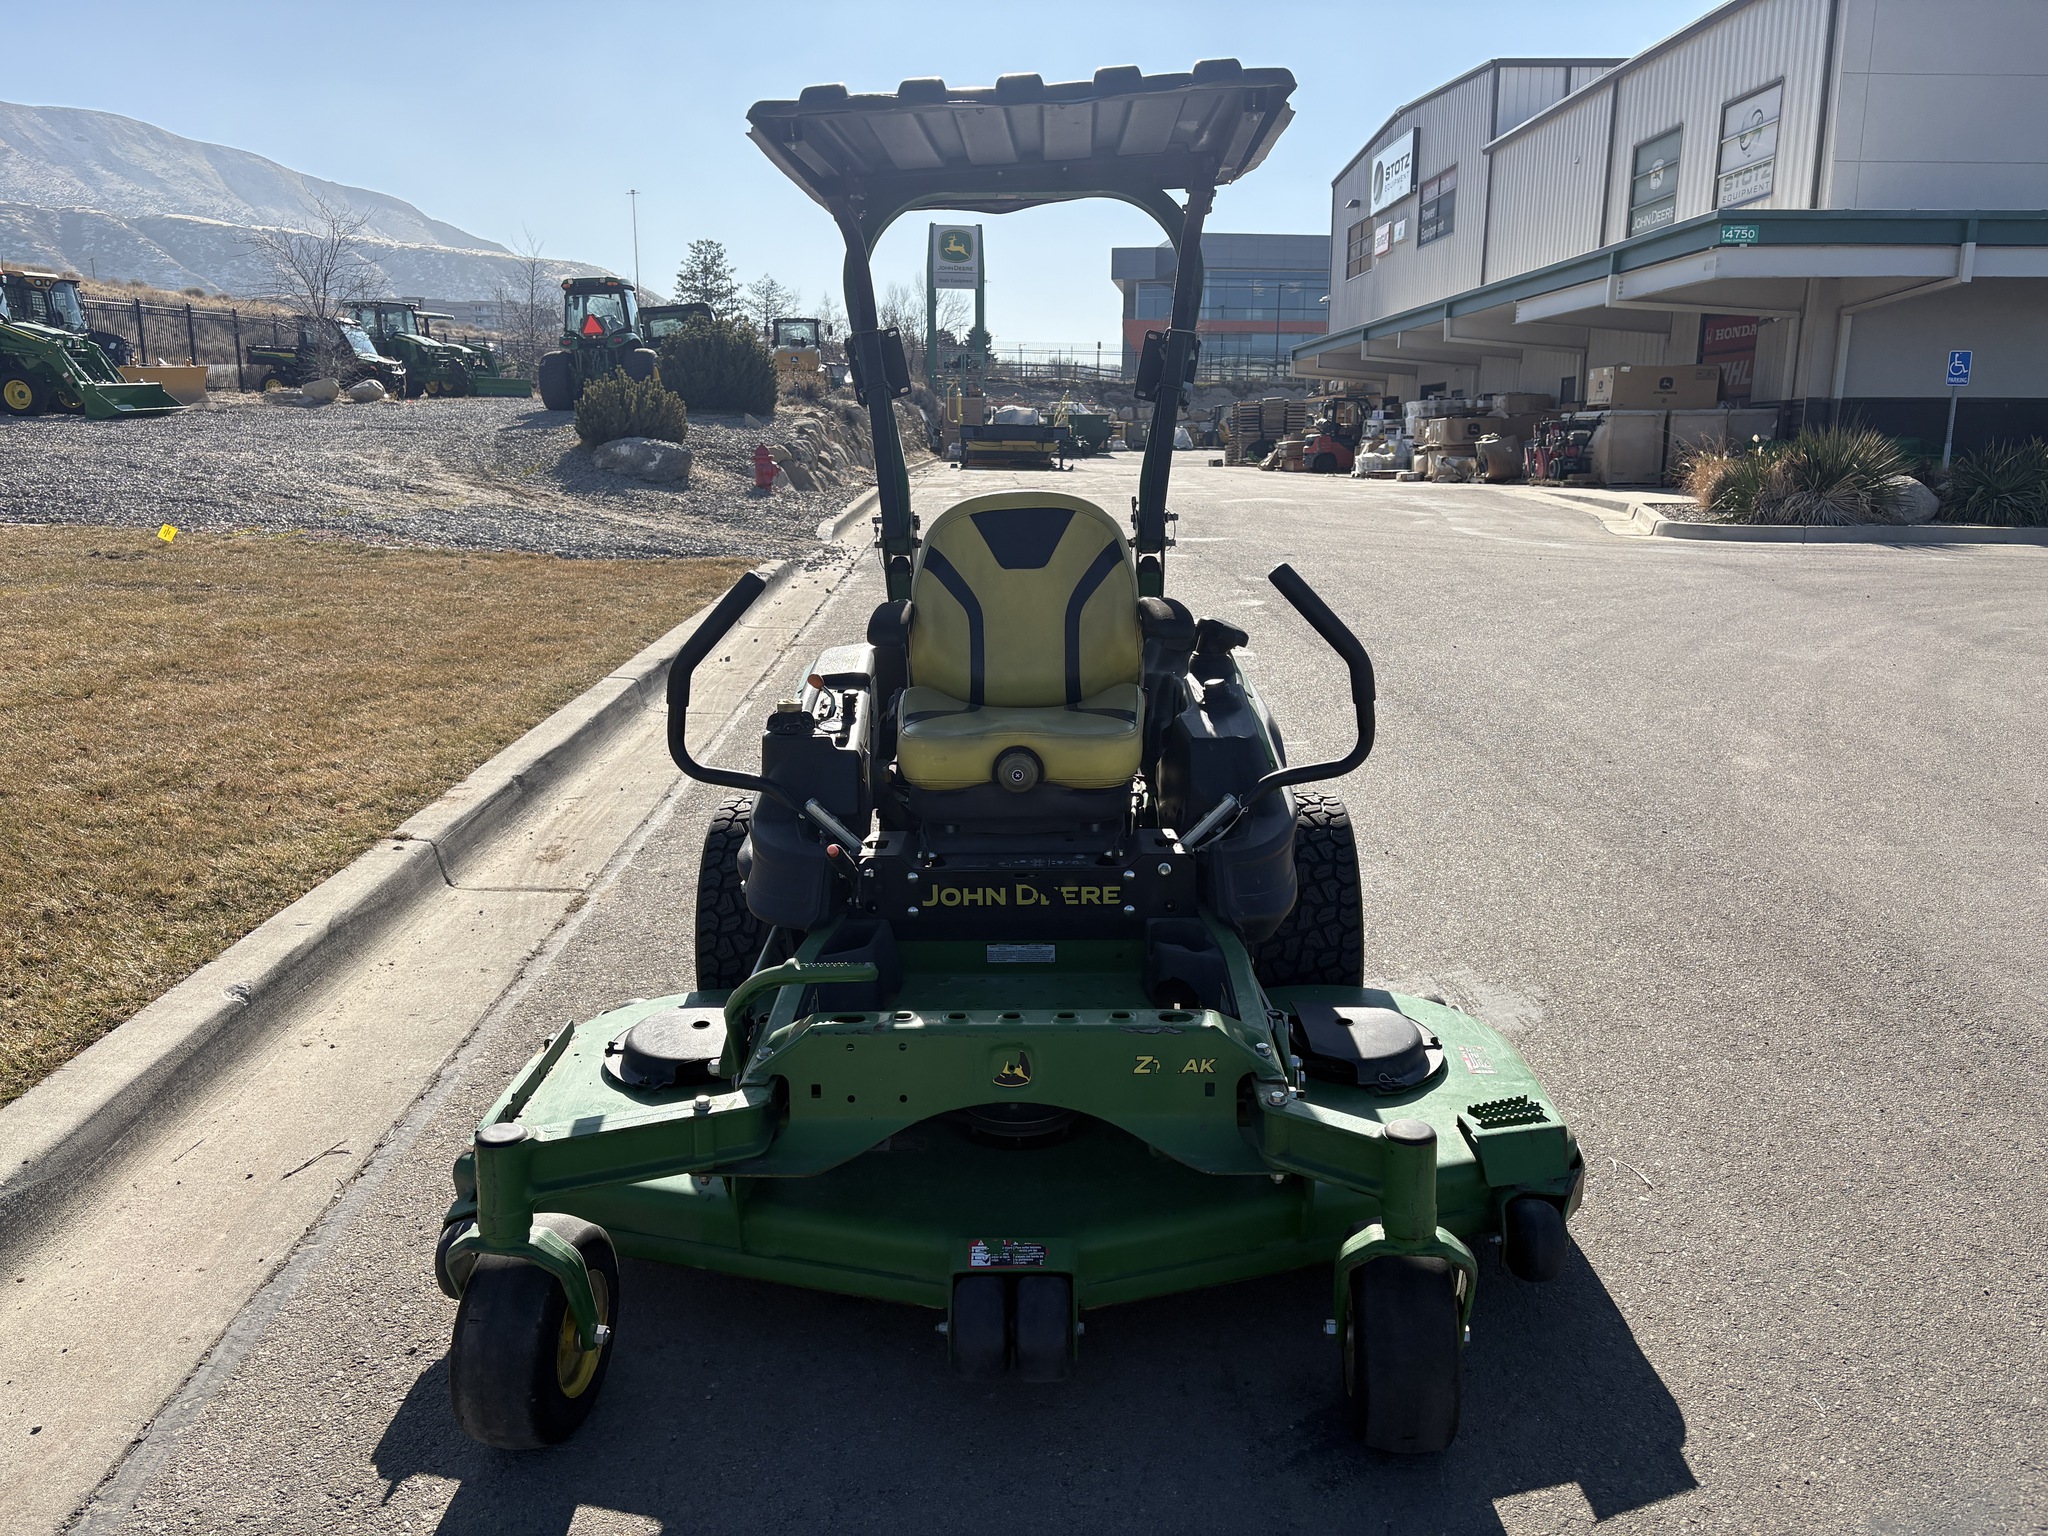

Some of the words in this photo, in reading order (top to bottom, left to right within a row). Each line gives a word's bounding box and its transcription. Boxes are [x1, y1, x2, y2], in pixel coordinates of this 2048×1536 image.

[1385, 152, 1410, 182] STOTZ
[1723, 161, 1772, 192] STOTZ
[1384, 171, 1410, 193] EQUIPMENT
[1722, 181, 1770, 204] EQUIPMENT
[1422, 208, 1436, 222] Power
[1631, 213, 1651, 231] JOHN
[1651, 205, 1674, 225] DEERE
[1722, 229, 1755, 239] 14750
[1715, 323, 1758, 341] HONDA
[1947, 376, 1968, 384] PARKING
[922, 884, 1007, 907] JOHN
[1015, 884, 1122, 906] DERE
